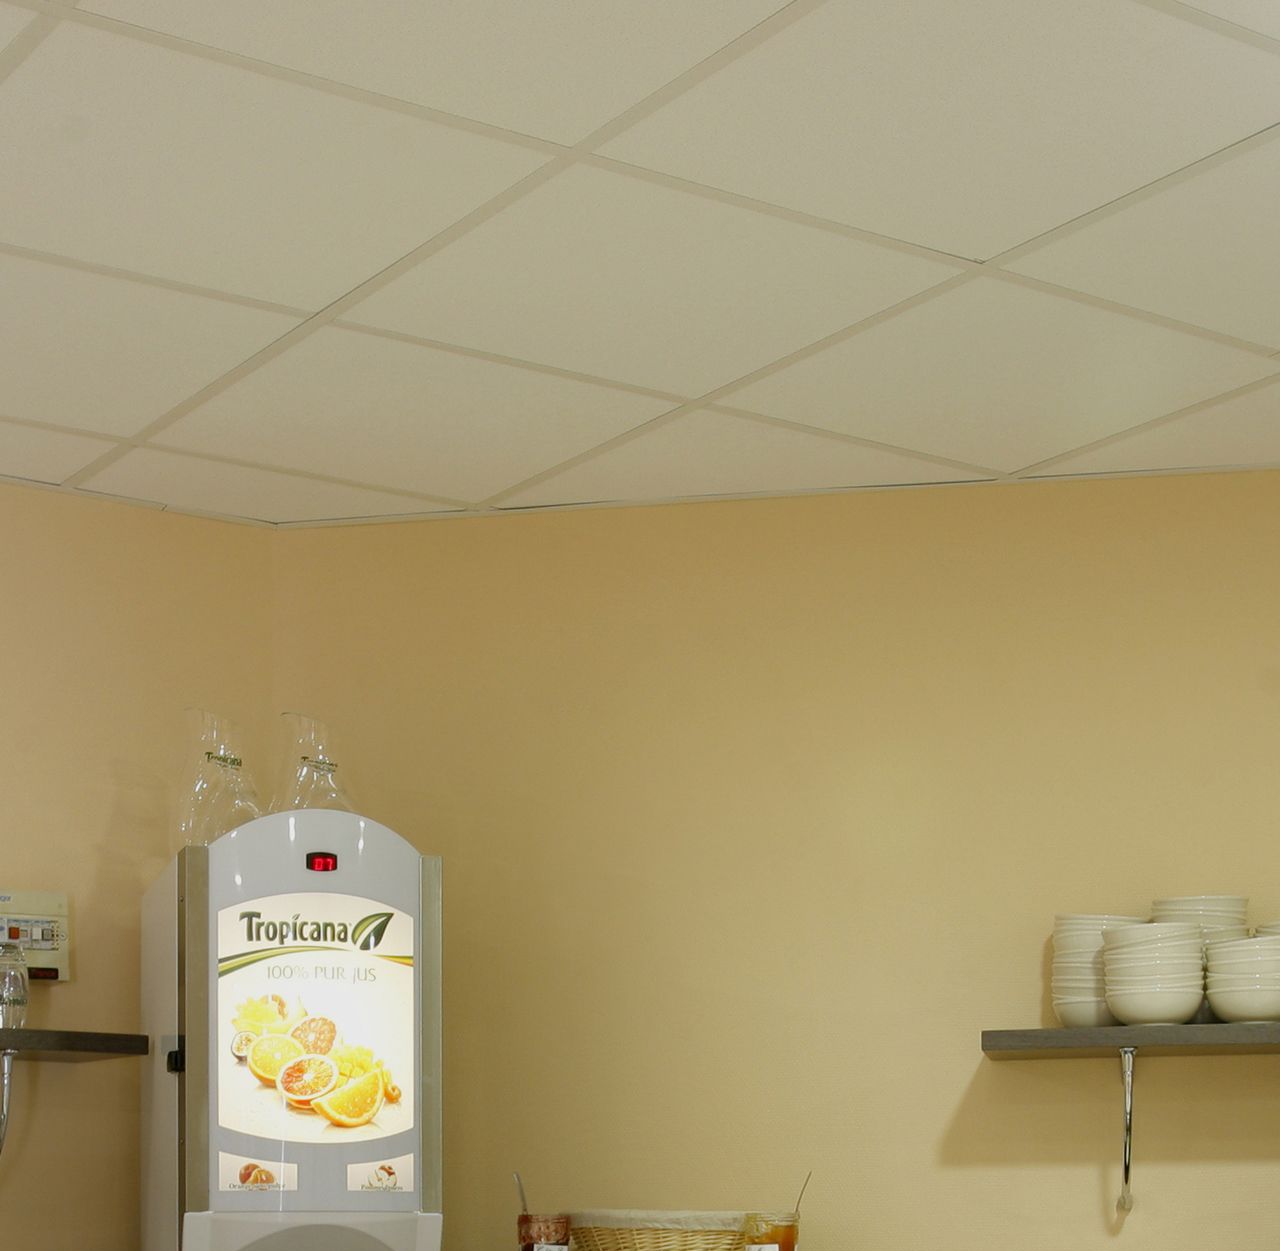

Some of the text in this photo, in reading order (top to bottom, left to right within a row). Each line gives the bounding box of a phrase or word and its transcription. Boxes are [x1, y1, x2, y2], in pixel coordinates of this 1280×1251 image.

[239, 911, 349, 945] Tropicana
[267, 965, 377, 985] 100% PUR JUS
